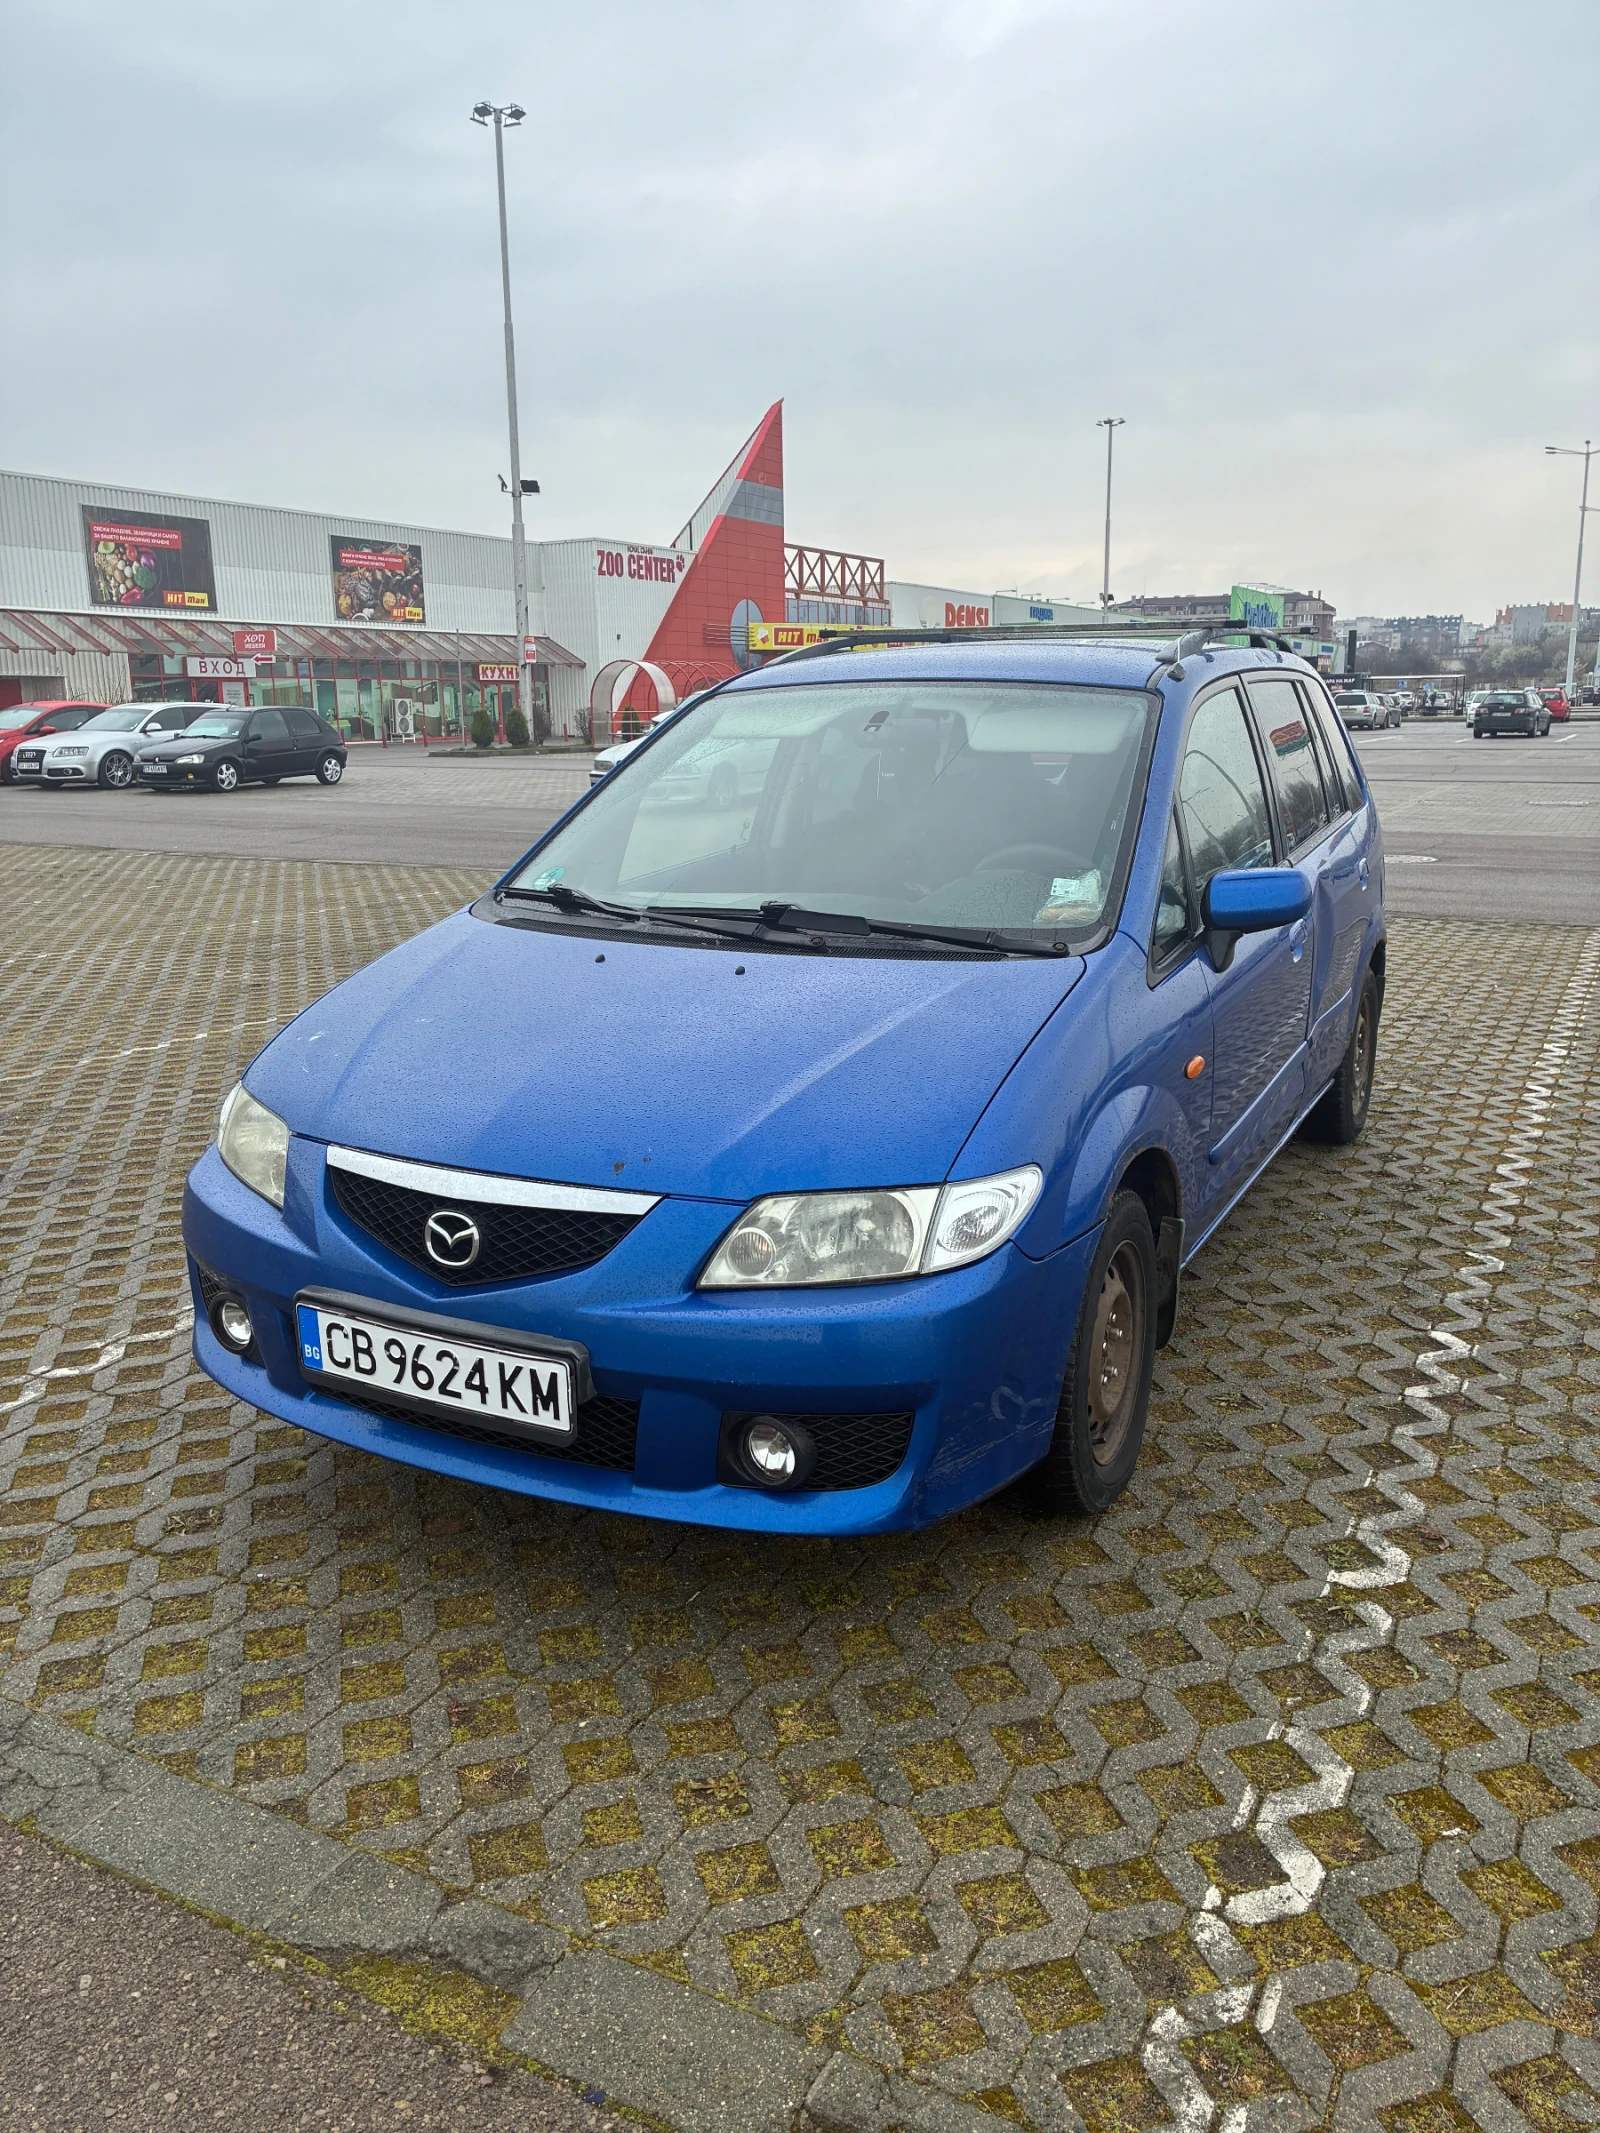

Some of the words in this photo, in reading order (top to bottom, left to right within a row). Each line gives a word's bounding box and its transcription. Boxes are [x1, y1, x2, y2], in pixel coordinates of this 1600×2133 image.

[596, 549, 624, 578] ZOO
[627, 553, 676, 584] CENTER
[167, 593, 183, 603] HIT
[393, 608, 405, 617] HIT
[945, 602, 989, 628] DENSI
[777, 631, 801, 644] HIT
[198, 660, 246, 677] ВХОД
[304, 1343, 320, 1360] BG
